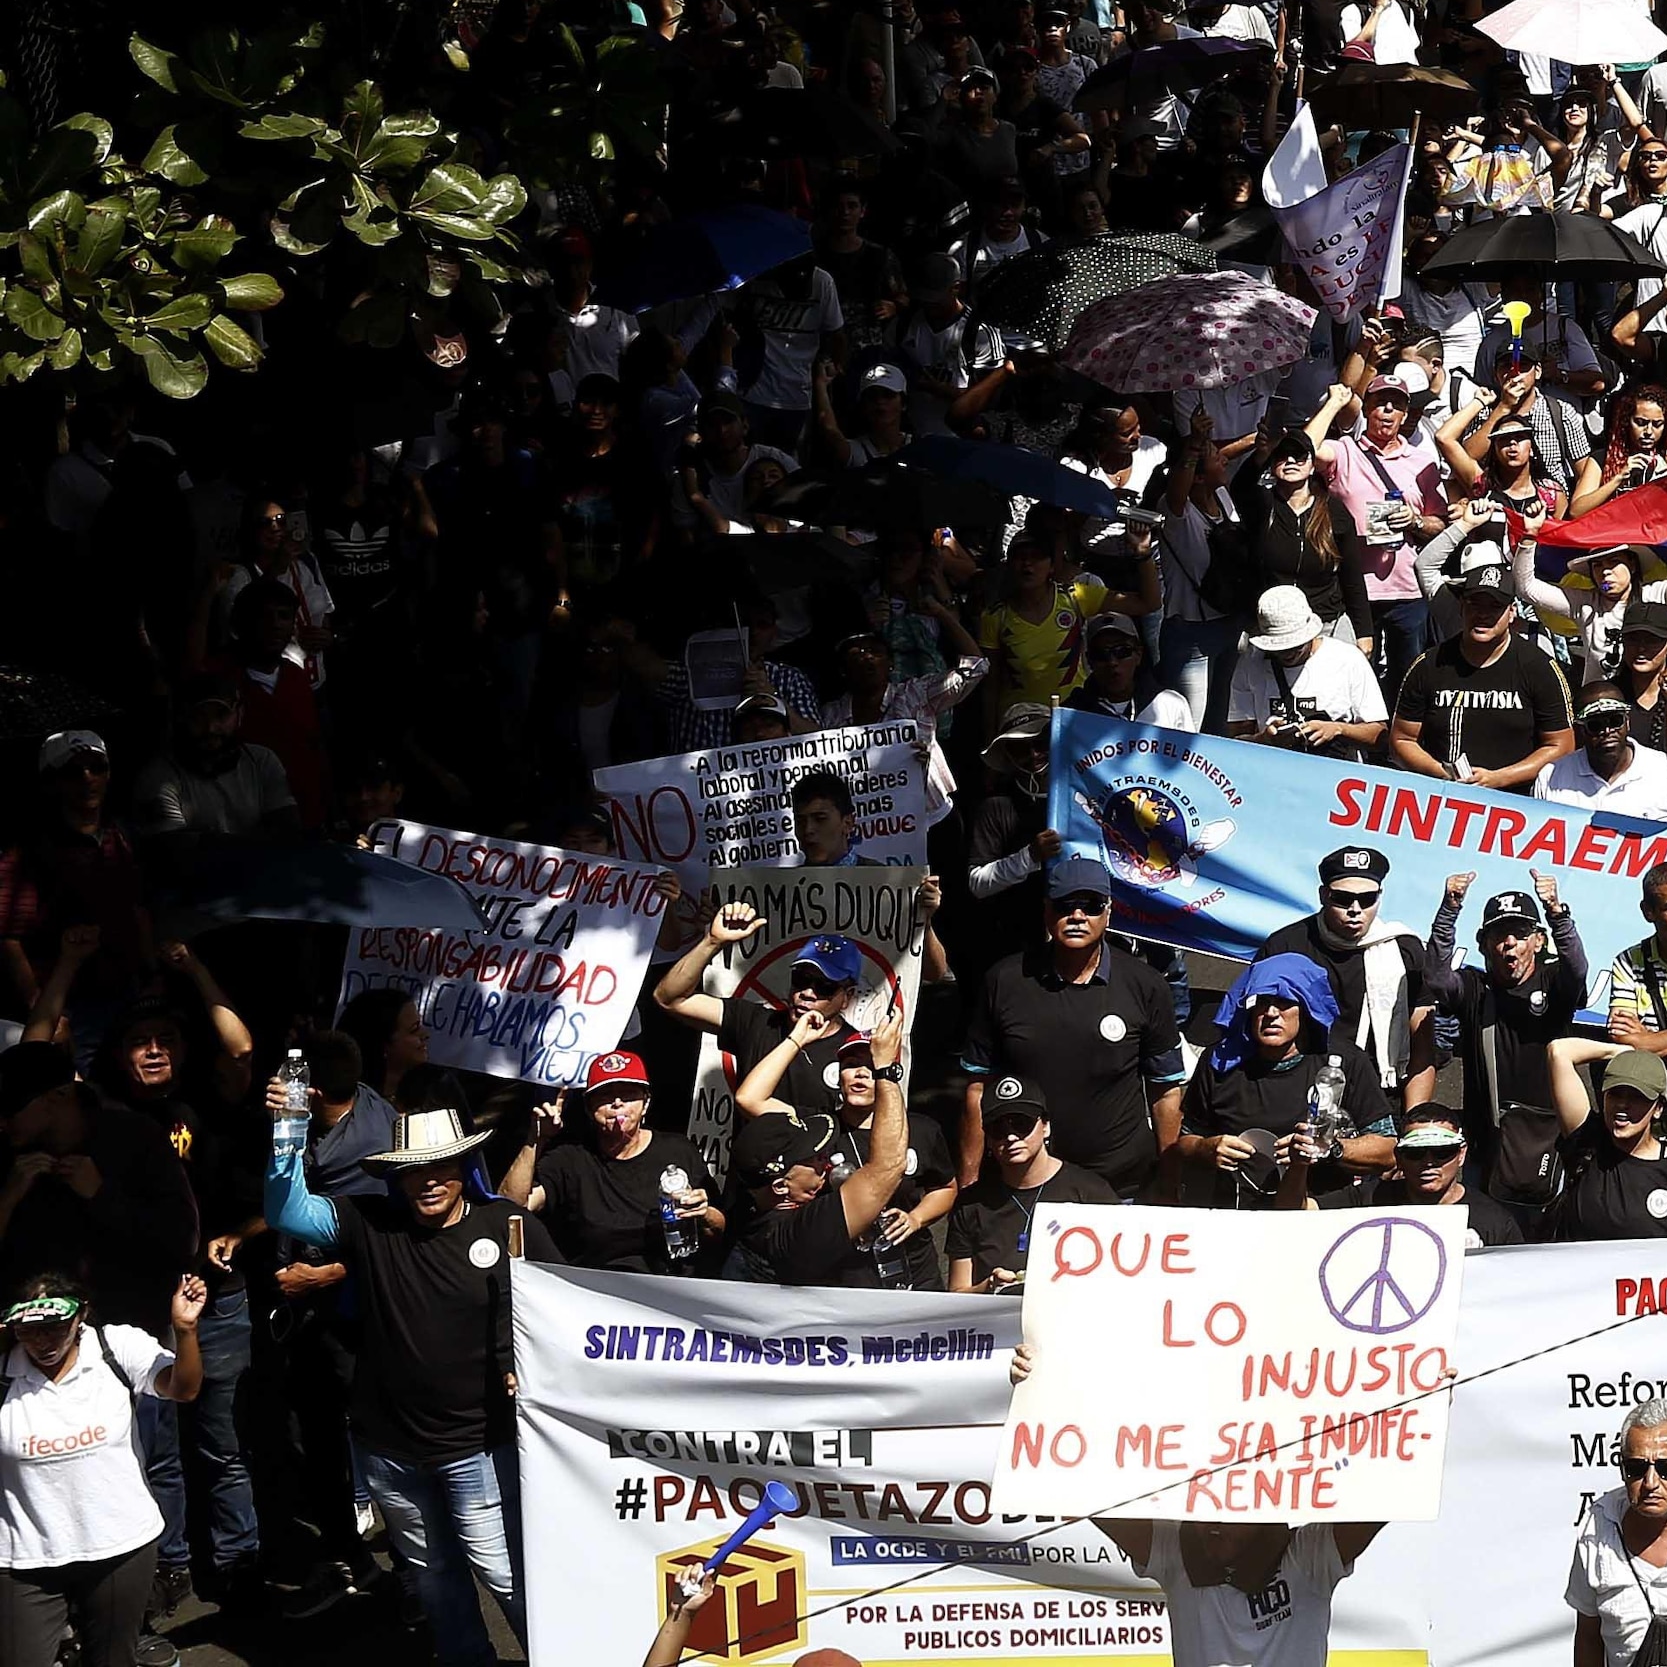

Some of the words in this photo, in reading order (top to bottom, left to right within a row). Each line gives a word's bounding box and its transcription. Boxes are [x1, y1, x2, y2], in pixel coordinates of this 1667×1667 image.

[718, 751, 738, 770] la
[742, 740, 818, 769] reforma
[818, 724, 918, 756] tributaria
[699, 771, 766, 799] laboral
[769, 770, 780, 788] y
[780, 753, 870, 787] pensional
[1074, 741, 1125, 775] UNIDOS
[1129, 739, 1161, 754] POR
[1163, 742, 1178, 758] EL
[1181, 748, 1244, 810] BIENESTAR
[611, 785, 696, 864] NO
[1097, 775, 1201, 828] SINTRAEMSDES
[705, 819, 778, 845] sociales
[418, 833, 667, 917] DESCONOCIMIENTO
[535, 904, 579, 950] LA
[764, 876, 829, 946] MÁS
[834, 880, 926, 958] DUQUE
[359, 927, 617, 1006] RESPONSABILIDAD
[450, 988, 586, 1052] HABLAMOS
[1051, 1225, 1196, 1283] QUE
[862, 1325, 995, 1364] Medellín
[1162, 1298, 1249, 1348] LO
[1242, 1342, 1448, 1402] INJUSTO
[28, 1423, 108, 1457] fecode
[618, 1429, 793, 1468] CONTRA
[813, 1429, 866, 1467] EL
[1011, 1421, 1088, 1471] NO
[1115, 1423, 1190, 1471] ME
[1209, 1420, 1279, 1466] SEA
[840, 1542, 868, 1559] LA
[875, 1542, 929, 1560] OCDE
[1033, 1544, 1077, 1565] POR
[1084, 1544, 1111, 1565] LA
[846, 1605, 887, 1626] POR
[895, 1604, 924, 1624] LA
[932, 1601, 1025, 1623] DEFENSA
[1034, 1600, 1060, 1620] DE
[1068, 1599, 1109, 1619] LOS
[904, 1628, 1002, 1651] PUBLICOS
[1010, 1625, 1165, 1648] DOMICILIARIOS
